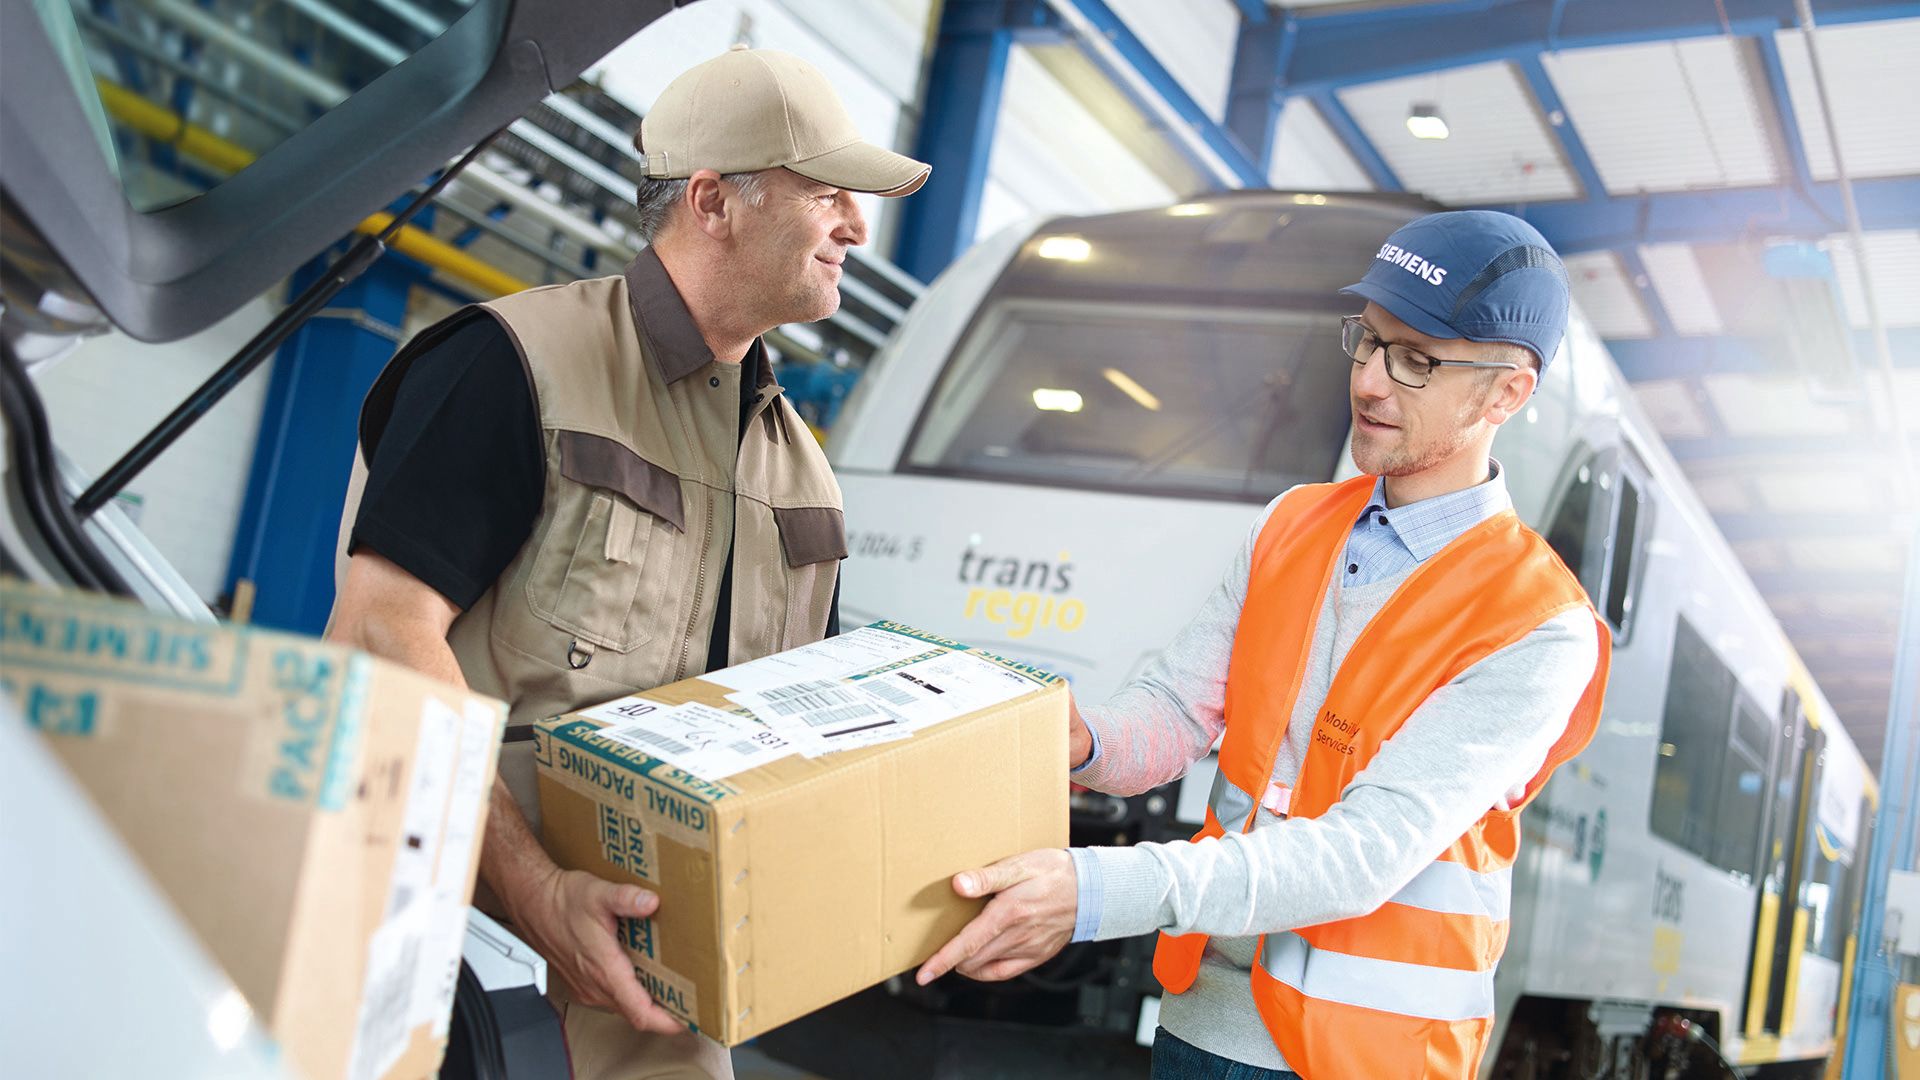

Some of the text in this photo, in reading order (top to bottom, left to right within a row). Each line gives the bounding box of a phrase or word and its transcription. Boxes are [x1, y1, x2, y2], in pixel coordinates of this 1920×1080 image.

[1376, 243, 1448, 286] SIEMENS
[958, 545, 1074, 594] trans
[963, 586, 1087, 639] regio
[617, 703, 658, 717] 40
[567, 725, 649, 766] SIEMENS
[751, 731, 791, 751] 931
[1315, 728, 1355, 756] Services
[558, 746, 706, 831] GINAL PACKING
